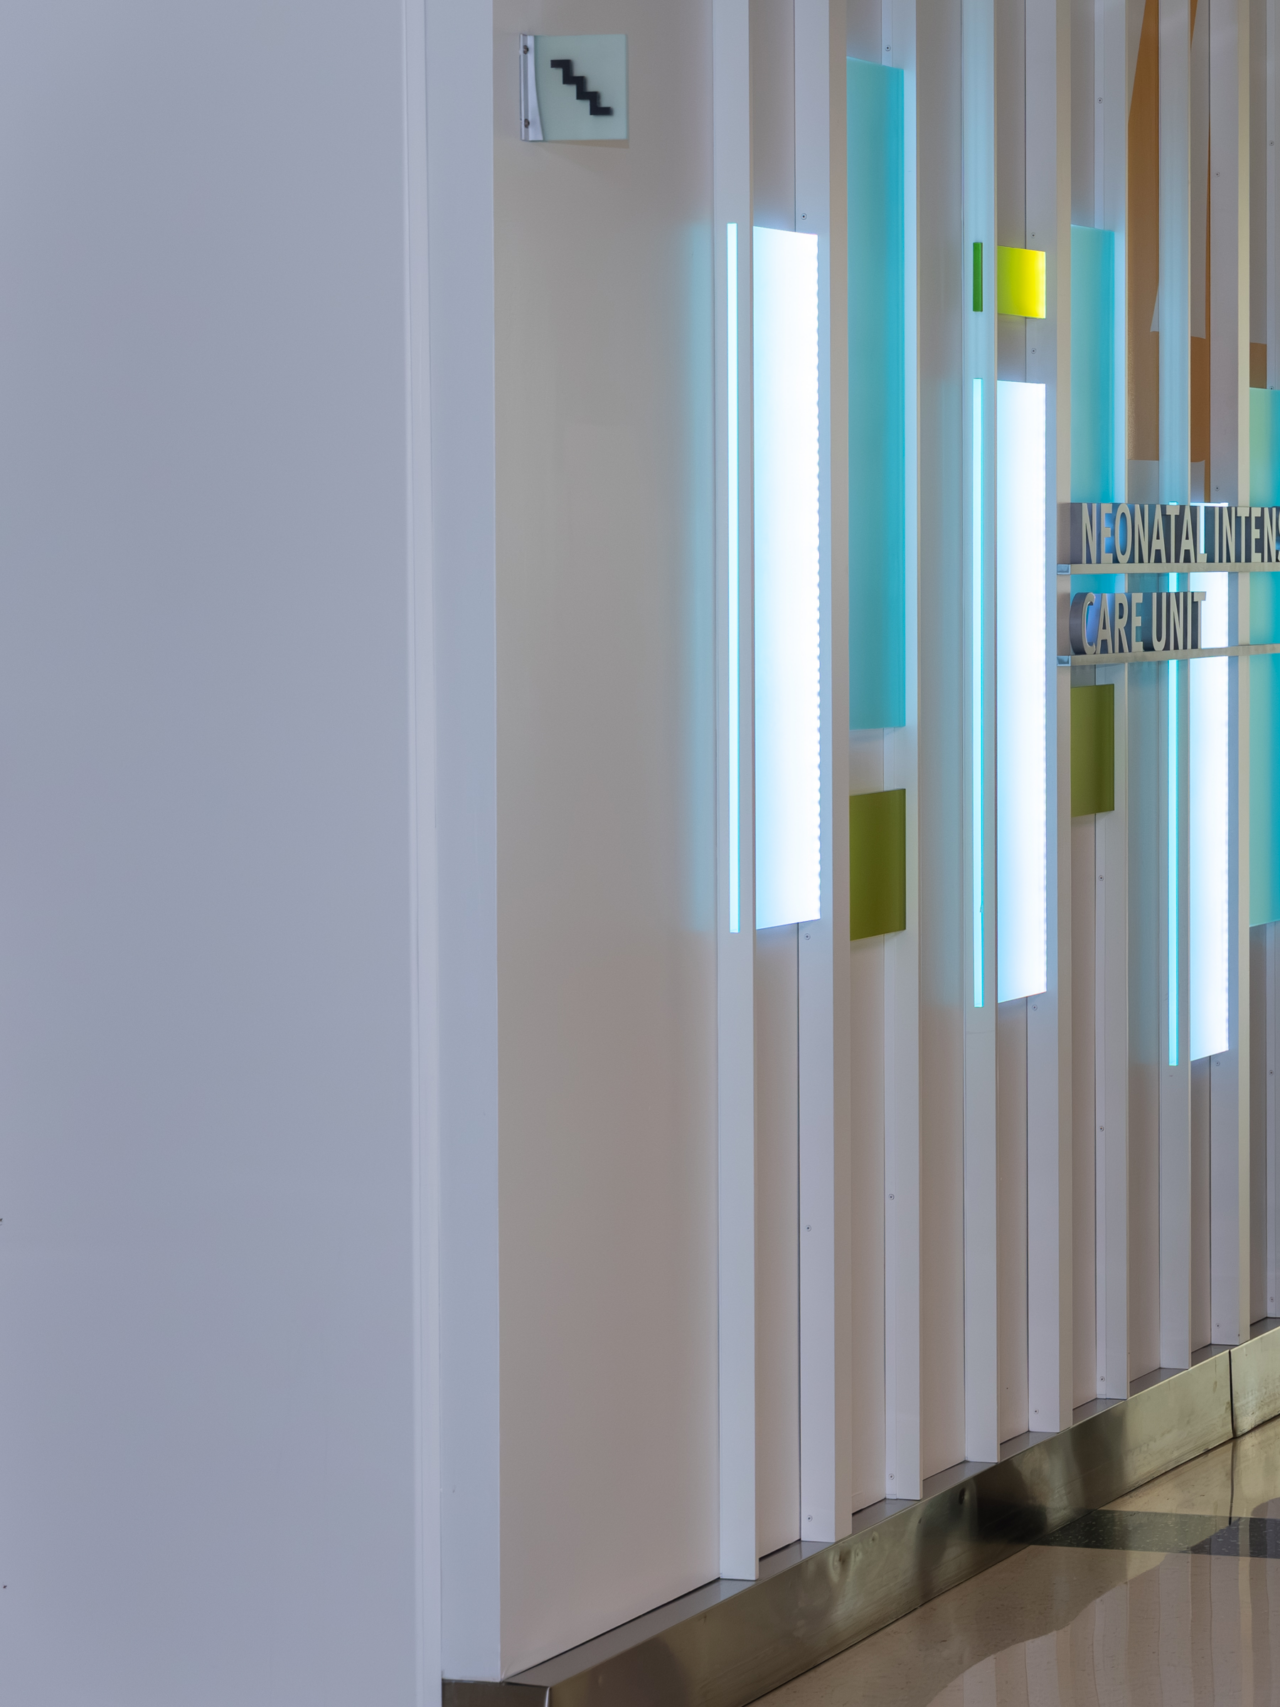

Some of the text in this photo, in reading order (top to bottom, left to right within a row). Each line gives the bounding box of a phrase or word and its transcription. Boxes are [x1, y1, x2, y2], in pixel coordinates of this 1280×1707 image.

[1081, 503, 1207, 564] NEONATAL
[1081, 591, 1207, 655] CARE UNIT
